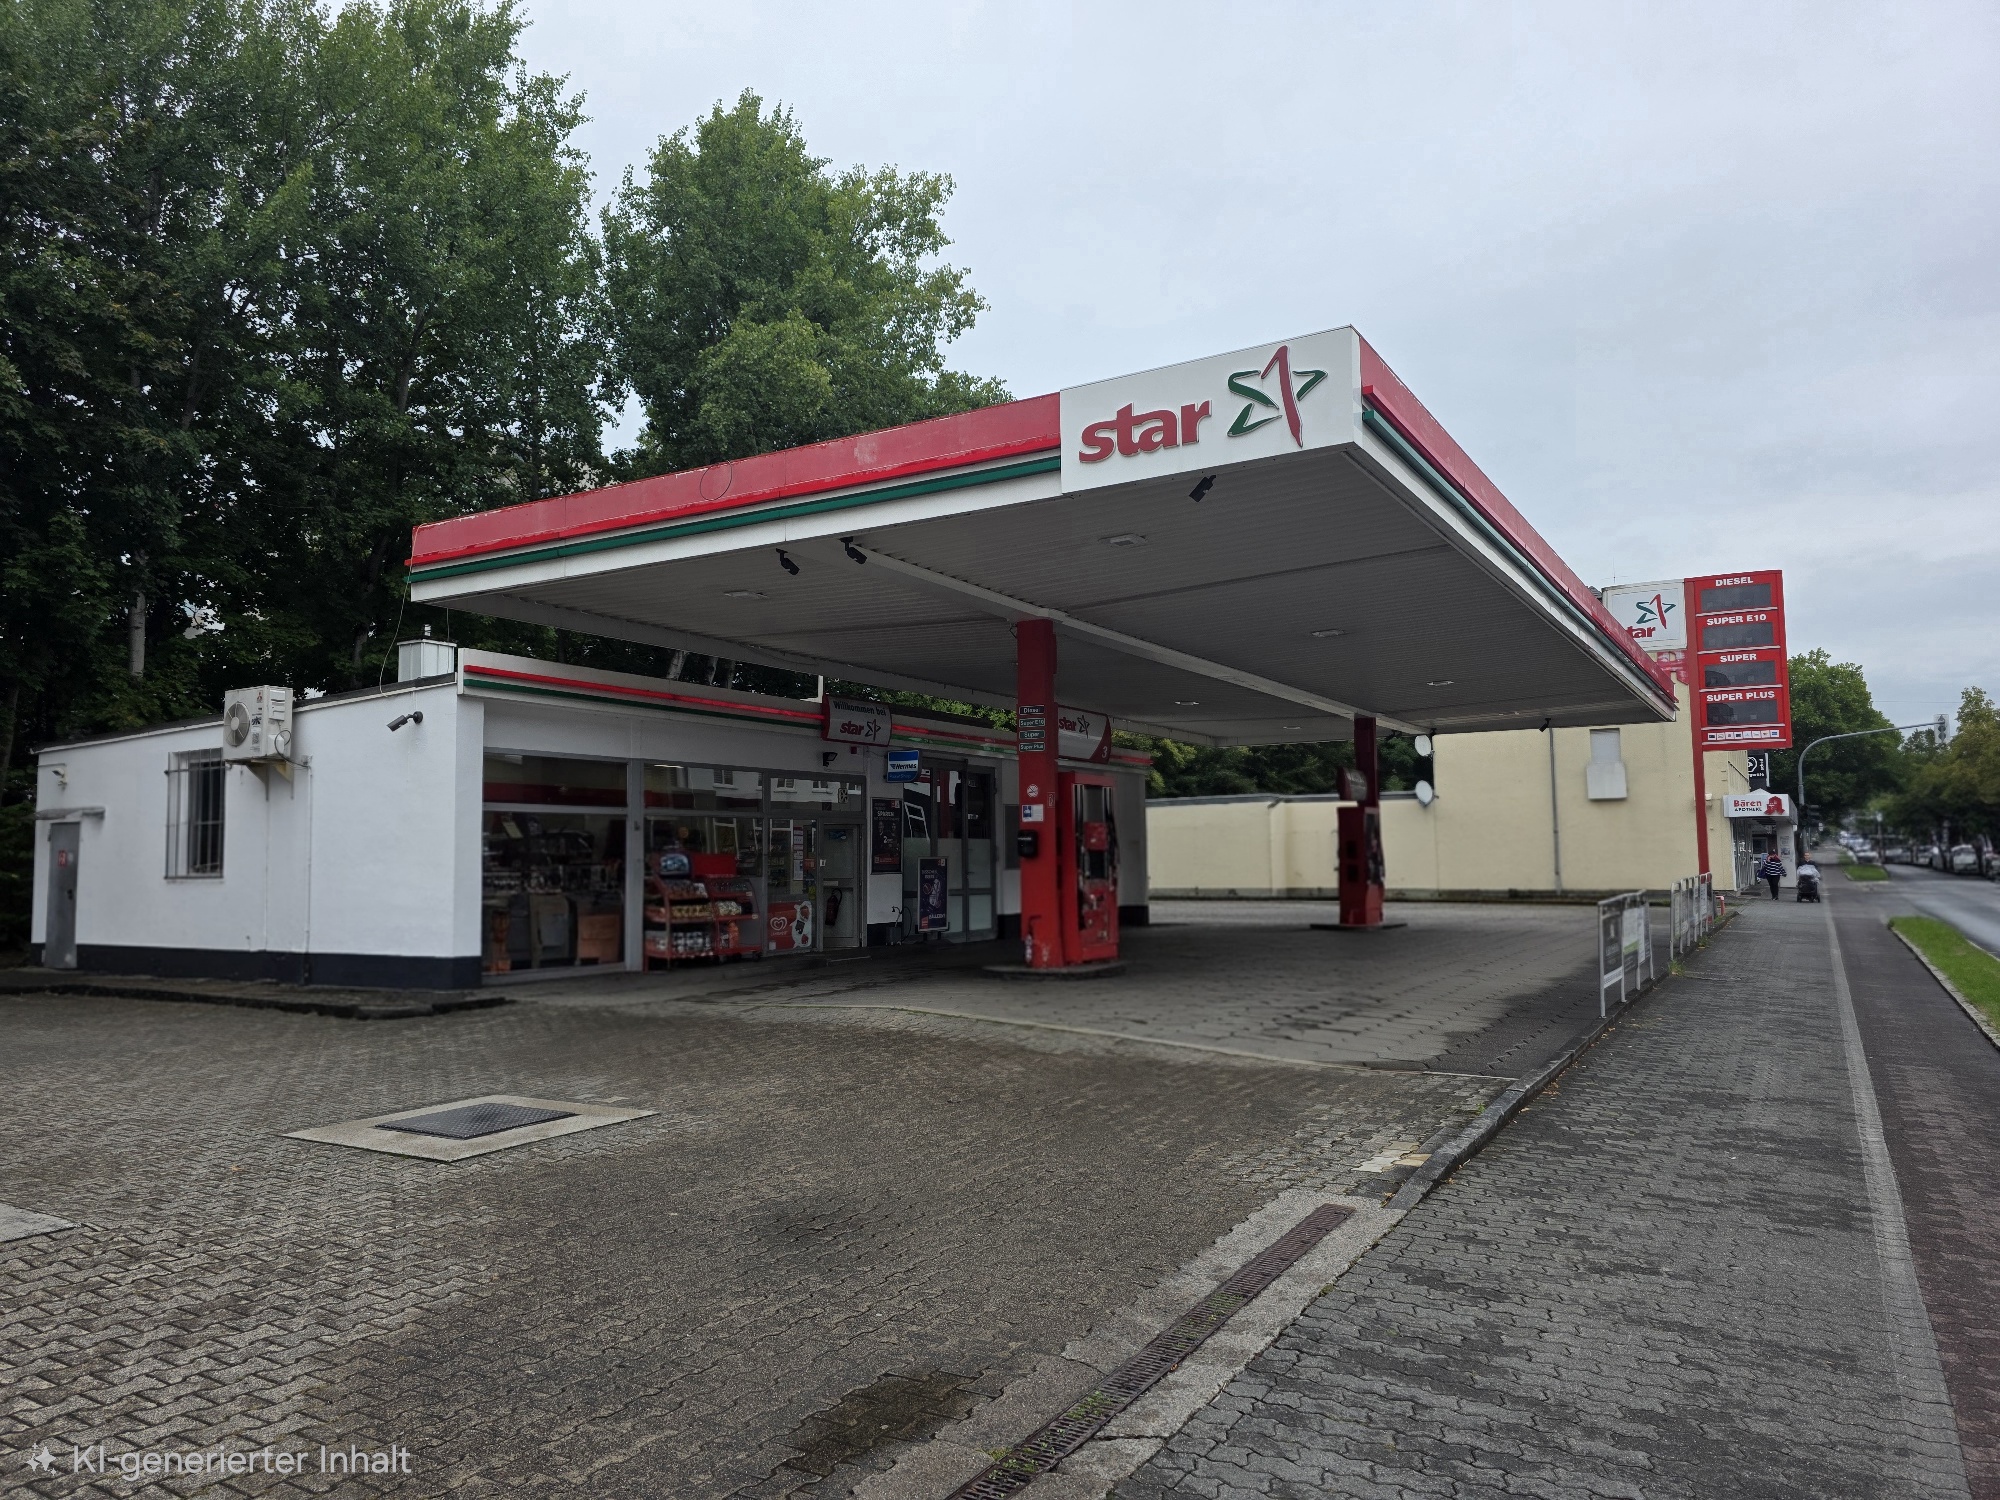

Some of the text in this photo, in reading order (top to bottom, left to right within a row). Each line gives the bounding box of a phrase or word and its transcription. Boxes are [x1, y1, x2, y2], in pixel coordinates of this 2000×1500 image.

[1079, 400, 1212, 463] star
[1715, 577, 1754, 587] DIESEL
[1706, 613, 1767, 626] SUPER E10
[1626, 626, 1656, 638] tar
[1719, 653, 1757, 662] SUPER
[1706, 690, 1775, 701] SUPER PLUS
[833, 701, 886, 716] Willkommen bei
[840, 720, 864, 735] star
[1058, 717, 1077, 731] star
[1101, 745, 1108, 758] 3
[1733, 799, 1762, 807] Bären
